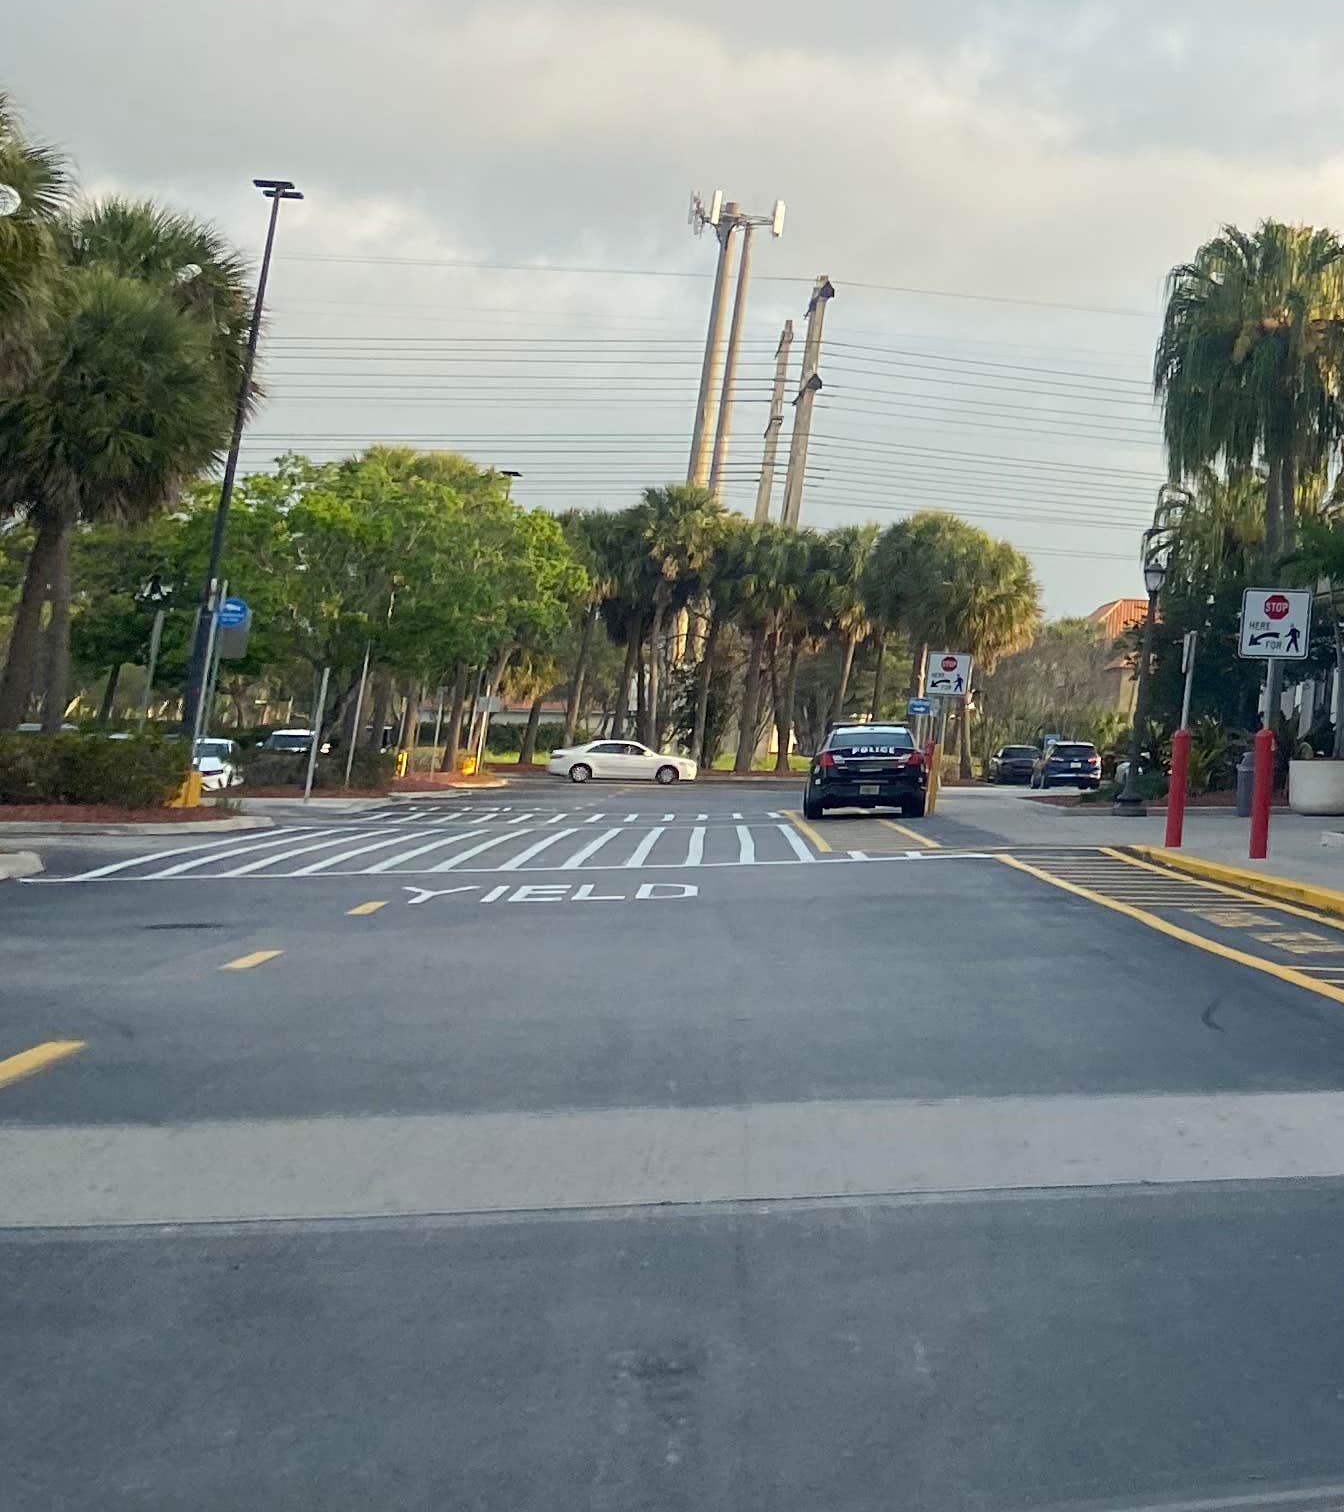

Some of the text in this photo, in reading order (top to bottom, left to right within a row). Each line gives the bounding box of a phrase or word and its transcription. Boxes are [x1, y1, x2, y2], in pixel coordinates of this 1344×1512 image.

[1265, 602, 1289, 613] STOP
[1249, 621, 1271, 631] HERE
[1265, 641, 1282, 650] FOR
[852, 746, 895, 755] POLICE
[402, 883, 699, 904] YIELD
